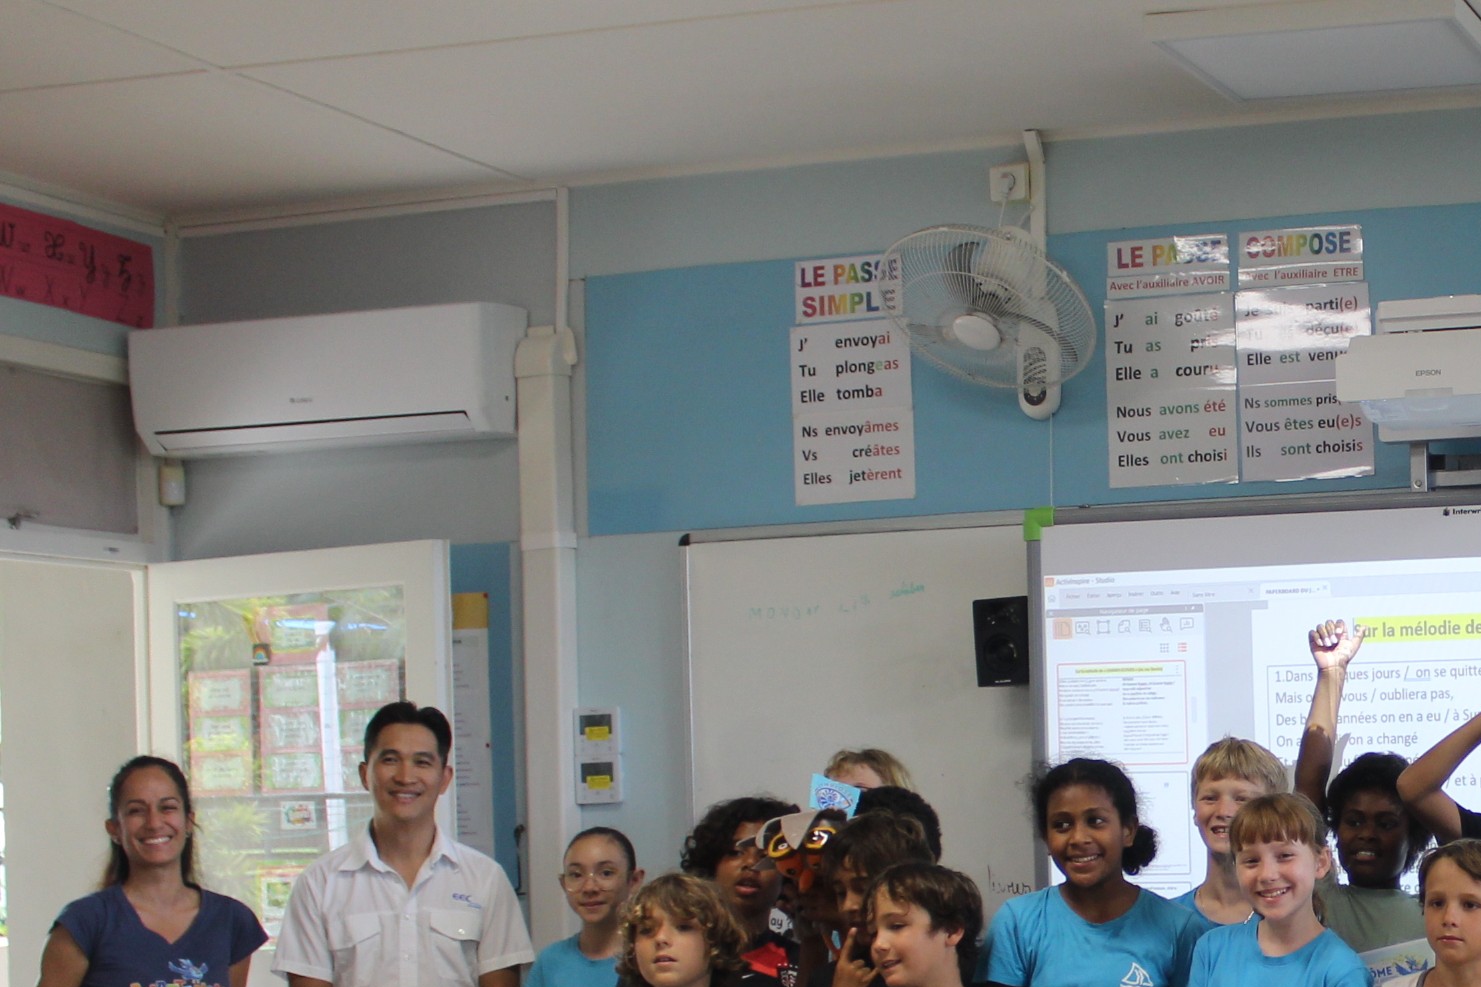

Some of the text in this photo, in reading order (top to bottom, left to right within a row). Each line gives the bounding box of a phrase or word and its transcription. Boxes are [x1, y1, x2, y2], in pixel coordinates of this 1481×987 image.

[1246, 231, 1352, 259] COMPOSE
[1117, 246, 1144, 269] LE
[800, 265, 826, 288] LE
[1333, 267, 1358, 278] ETRE
[1109, 281, 1134, 291] Avec
[1191, 275, 1225, 287] AVOIR
[835, 332, 890, 350] envoyai
[1114, 341, 1133, 354] Tu
[1246, 350, 1301, 366] Elle est
[799, 357, 899, 378] Tu plongeas
[1115, 367, 1142, 381] Elle
[1415, 369, 1441, 377] EPSON
[800, 385, 883, 404] Elle tomba
[1264, 396, 1312, 408] sommes
[1116, 400, 1226, 418] Nous avons été
[825, 420, 899, 440] envoyâmes
[1245, 420, 1280, 433] Vous
[1284, 417, 1314, 431] êtes
[1117, 427, 1226, 443] Vous avez eu
[802, 443, 900, 462] Vs créâtes
[1246, 440, 1363, 458] Ils sont choisis
[1117, 449, 1227, 468] Elles ont choisi
[803, 467, 903, 486] Elles jetèrent
[1382, 622, 1395, 637] la
[1399, 620, 1460, 637] mélodie
[1372, 669, 1400, 684] jours
[1276, 688, 1454, 704] Mais oubliera pas,
[1276, 712, 1379, 726] Des années
[1377, 733, 1418, 748] changé
[1371, 966, 1392, 979] ÔME
